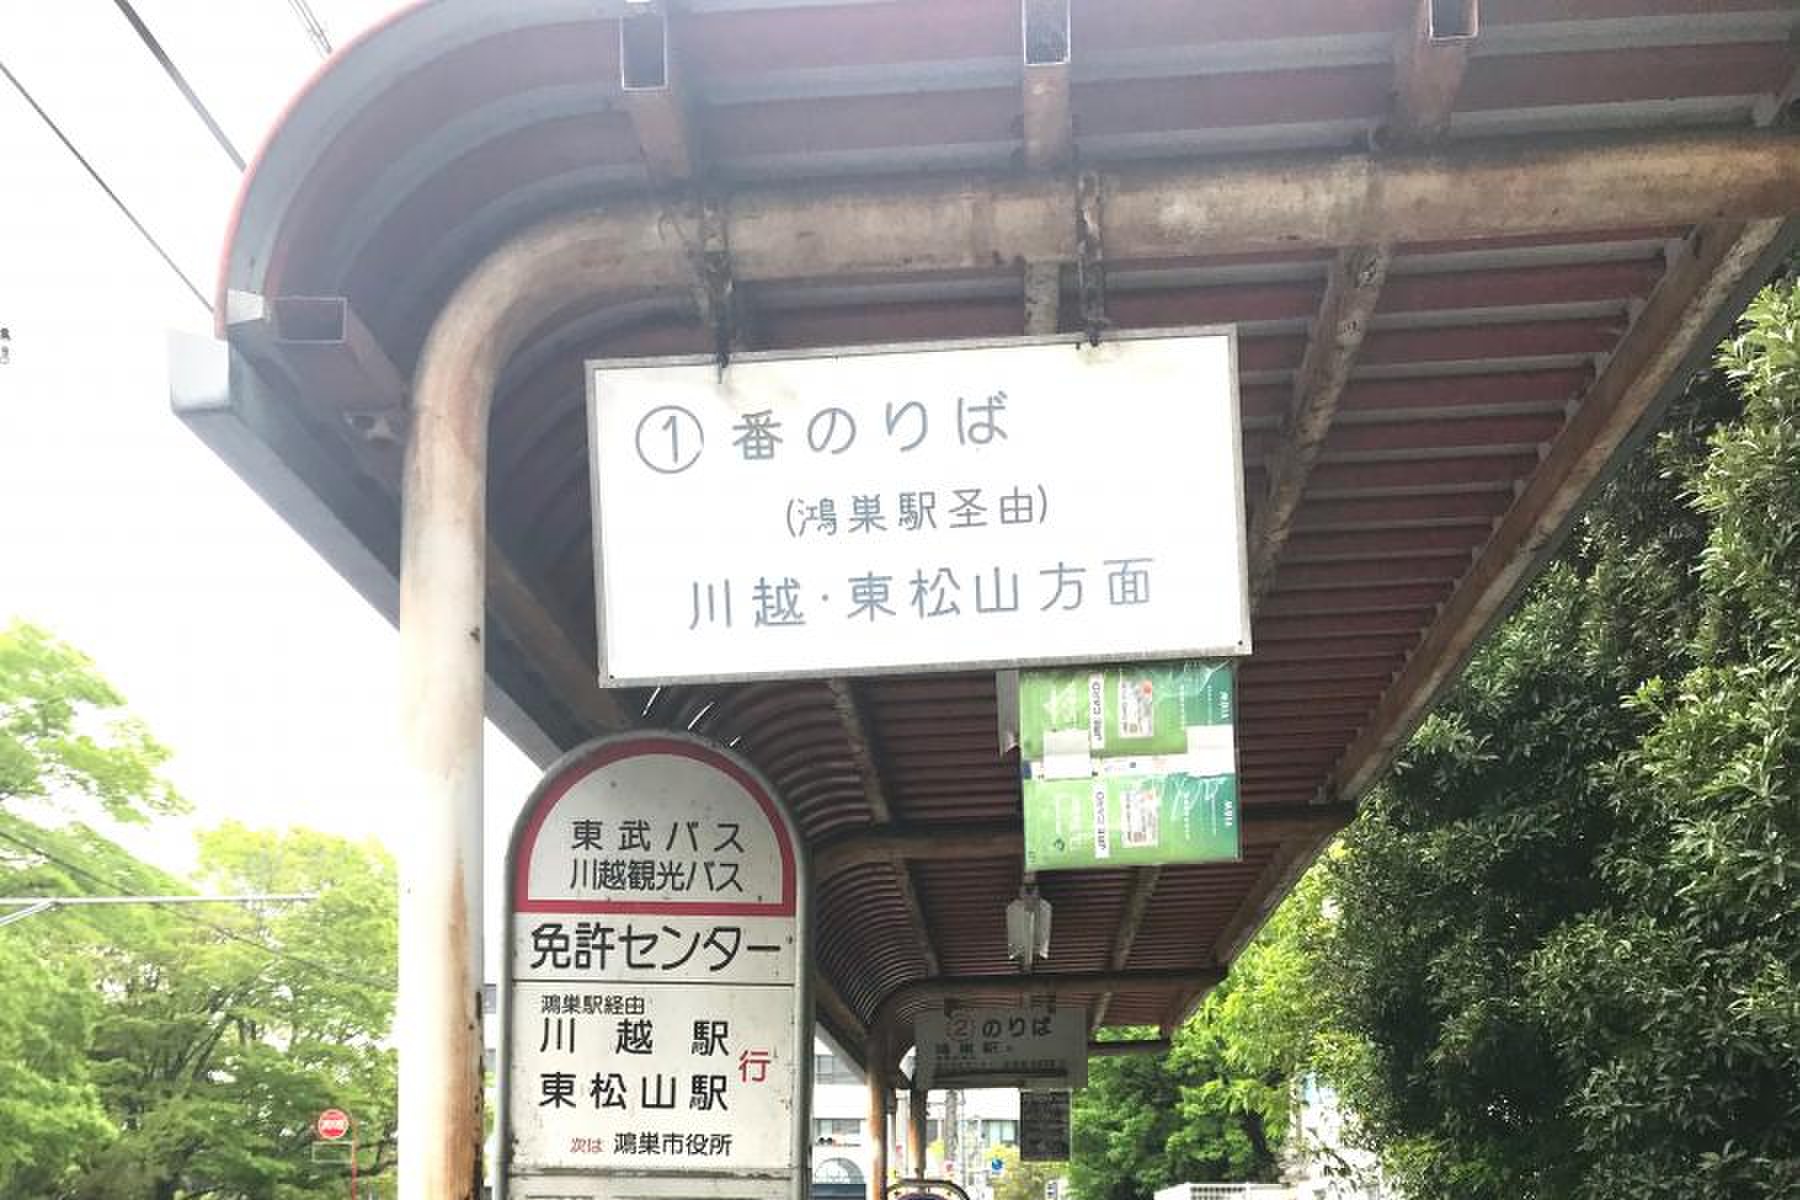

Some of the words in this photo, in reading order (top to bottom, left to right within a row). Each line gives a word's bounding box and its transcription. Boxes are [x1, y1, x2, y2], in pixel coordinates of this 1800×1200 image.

[572, 820, 744, 853] 東武バス
[570, 859, 743, 893] 川越観光バス
[530, 922, 781, 971] 免許センター
[541, 994, 645, 1015] 鴻巣駅経由
[540, 1017, 729, 1057] 川越駅
[739, 1050, 771, 1083] 行
[539, 1072, 728, 1111] 東松山駅
[613, 1132, 732, 1157] 鴻巣市役所
